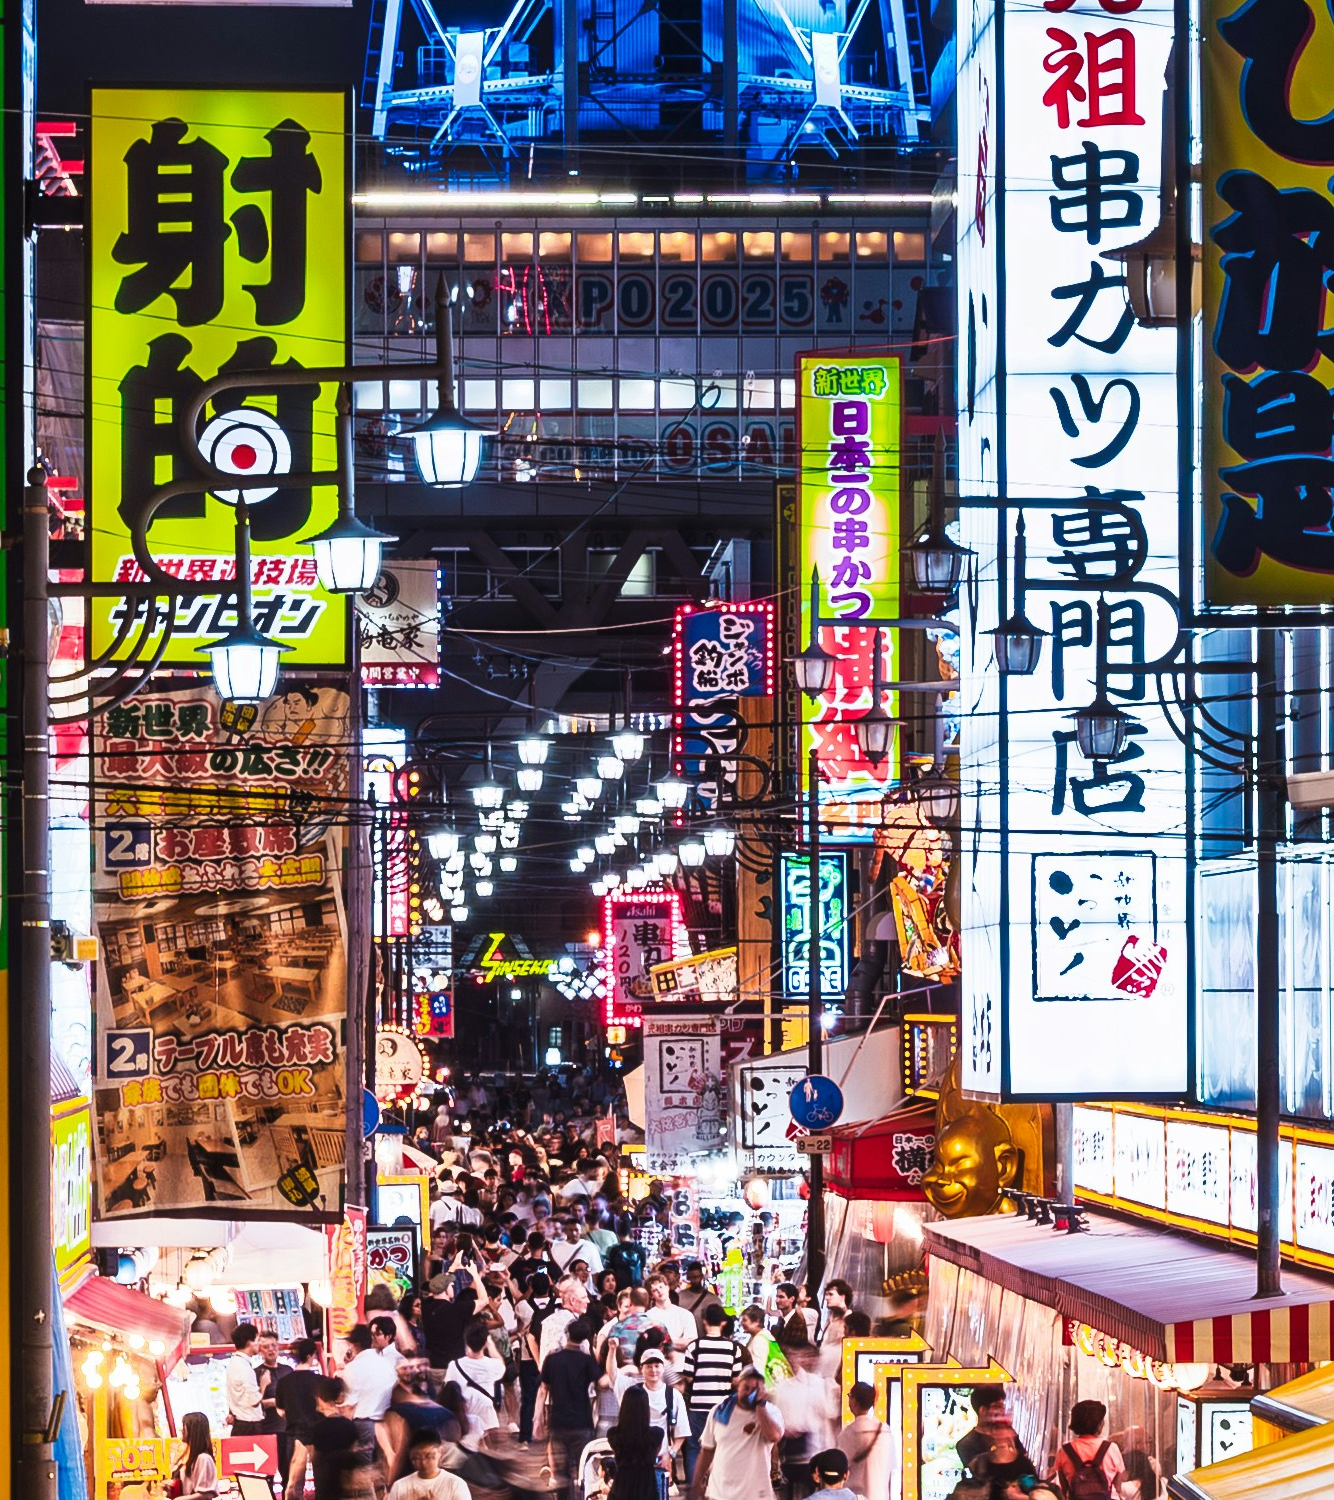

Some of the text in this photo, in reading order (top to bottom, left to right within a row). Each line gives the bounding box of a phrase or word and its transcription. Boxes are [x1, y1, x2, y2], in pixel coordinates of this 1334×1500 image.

[661, 272, 816, 328] 2025
[113, 117, 323, 541] 射的
[814, 367, 887, 398] 新世界
[829, 399, 873, 621] 日本一の串かつ
[105, 703, 213, 740] 新世界
[155, 1028, 334, 1072] テーブル席も充実
[122, 1069, 314, 1107] 家族でも団体でもOK
[895, 1145, 935, 1173] 横
